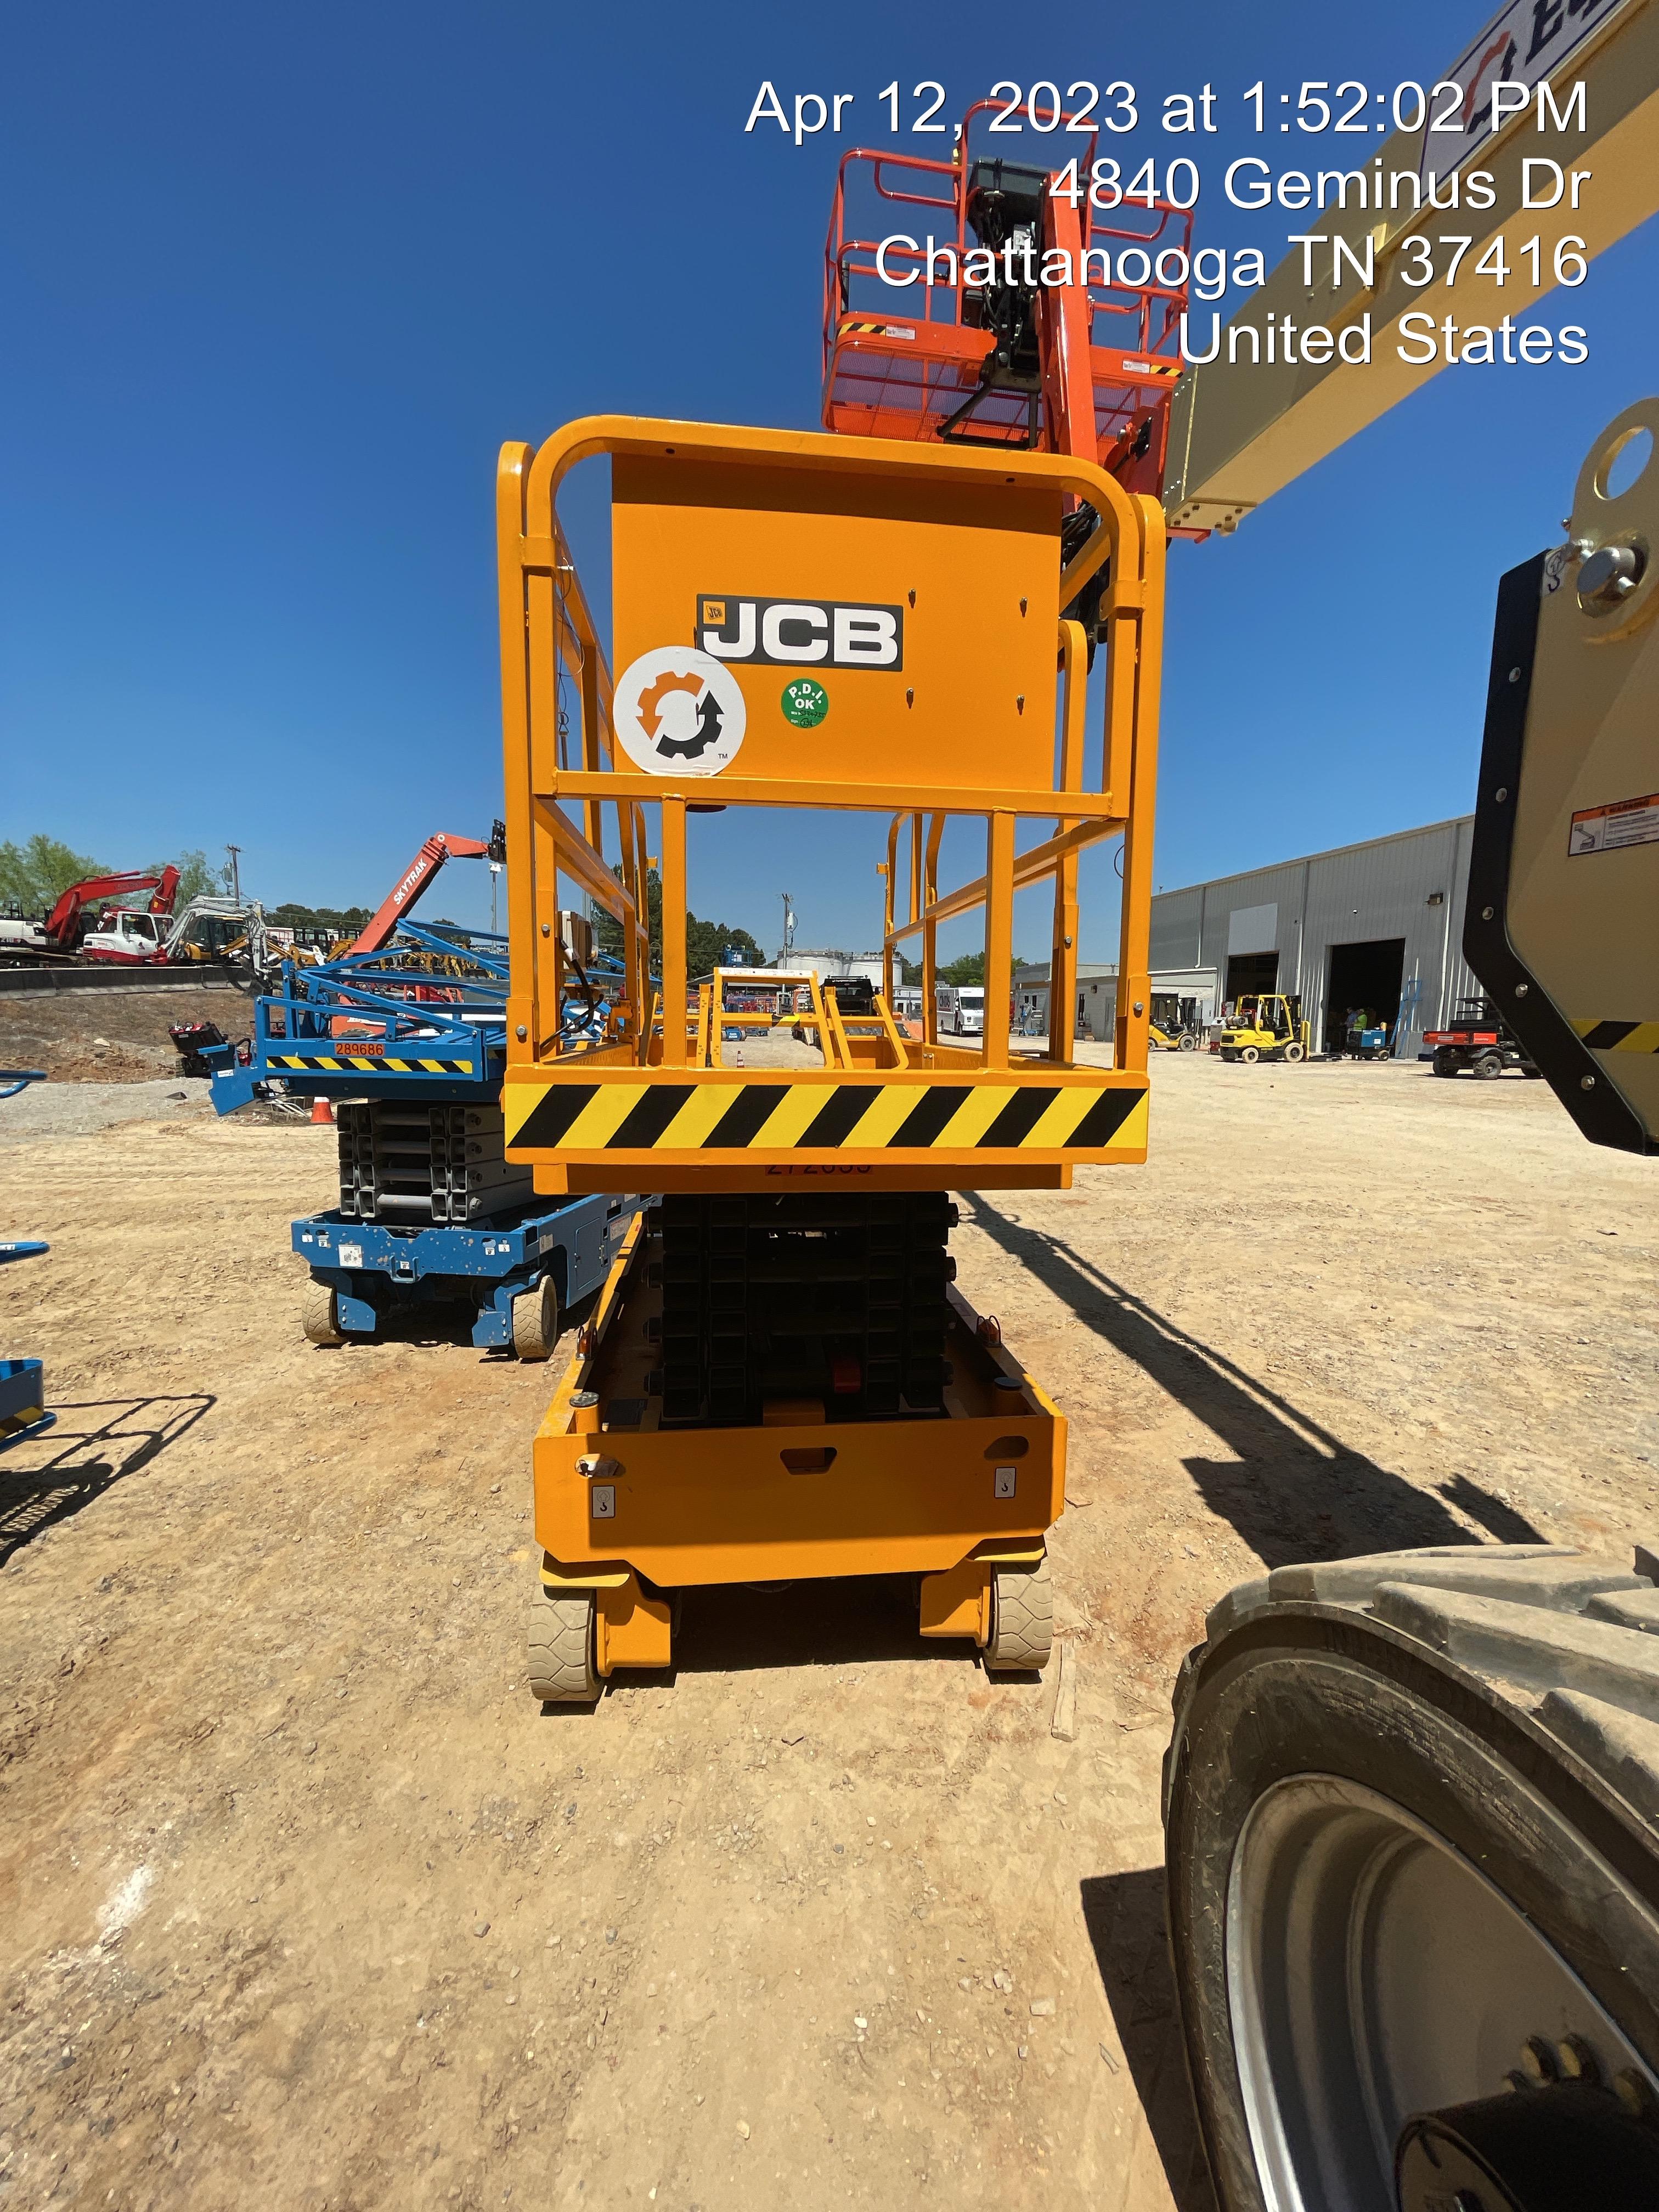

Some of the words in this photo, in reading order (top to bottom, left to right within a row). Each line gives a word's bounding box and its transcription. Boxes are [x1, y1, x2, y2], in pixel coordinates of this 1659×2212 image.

[703, 602, 898, 664] JCB
[795, 698, 815, 709] OK
[393, 857, 427, 905] SKYTRAK
[336, 1043, 383, 1055] 289686
